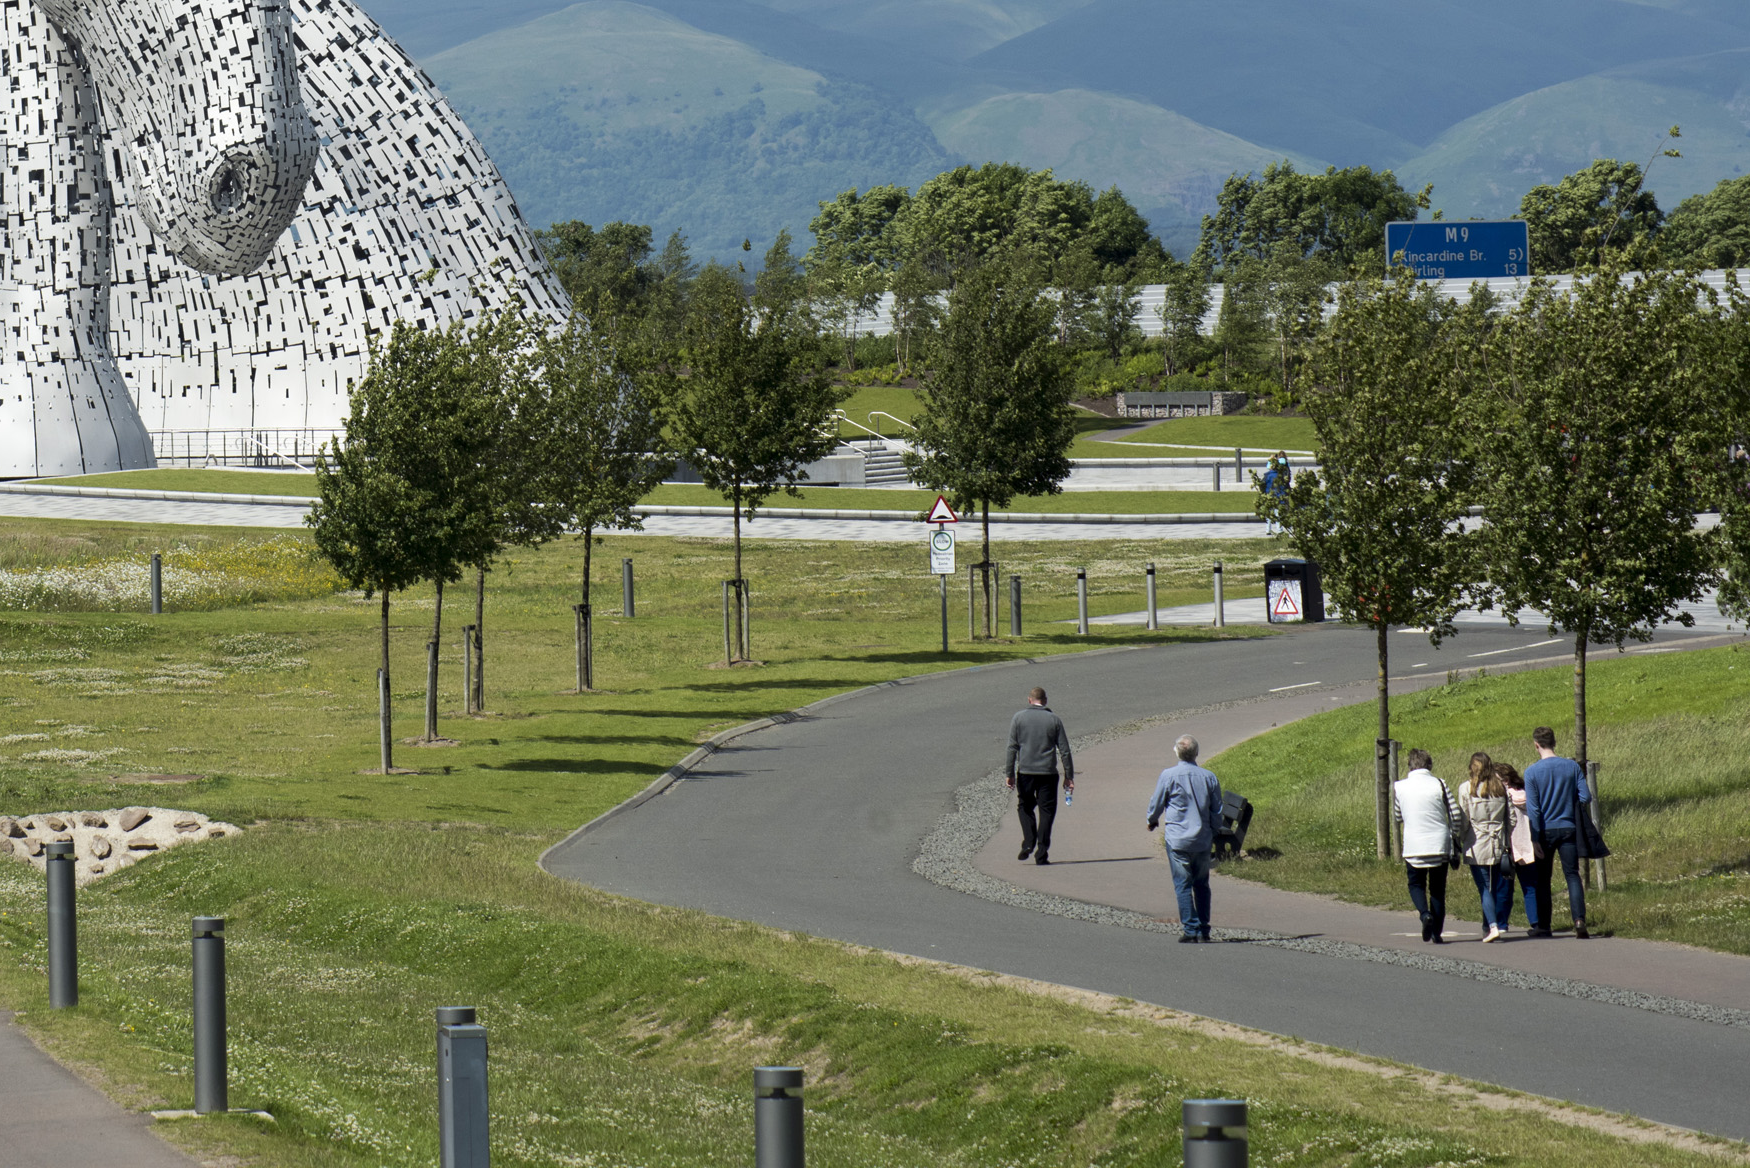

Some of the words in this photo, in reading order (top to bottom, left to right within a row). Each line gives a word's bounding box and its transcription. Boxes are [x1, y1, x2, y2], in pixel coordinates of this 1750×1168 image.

[1445, 227, 1457, 243] M
[1461, 227, 1469, 243] 9
[1469, 249, 1487, 262] Br.
[1508, 247, 1524, 262] 5)
[1504, 263, 1518, 275] 13
